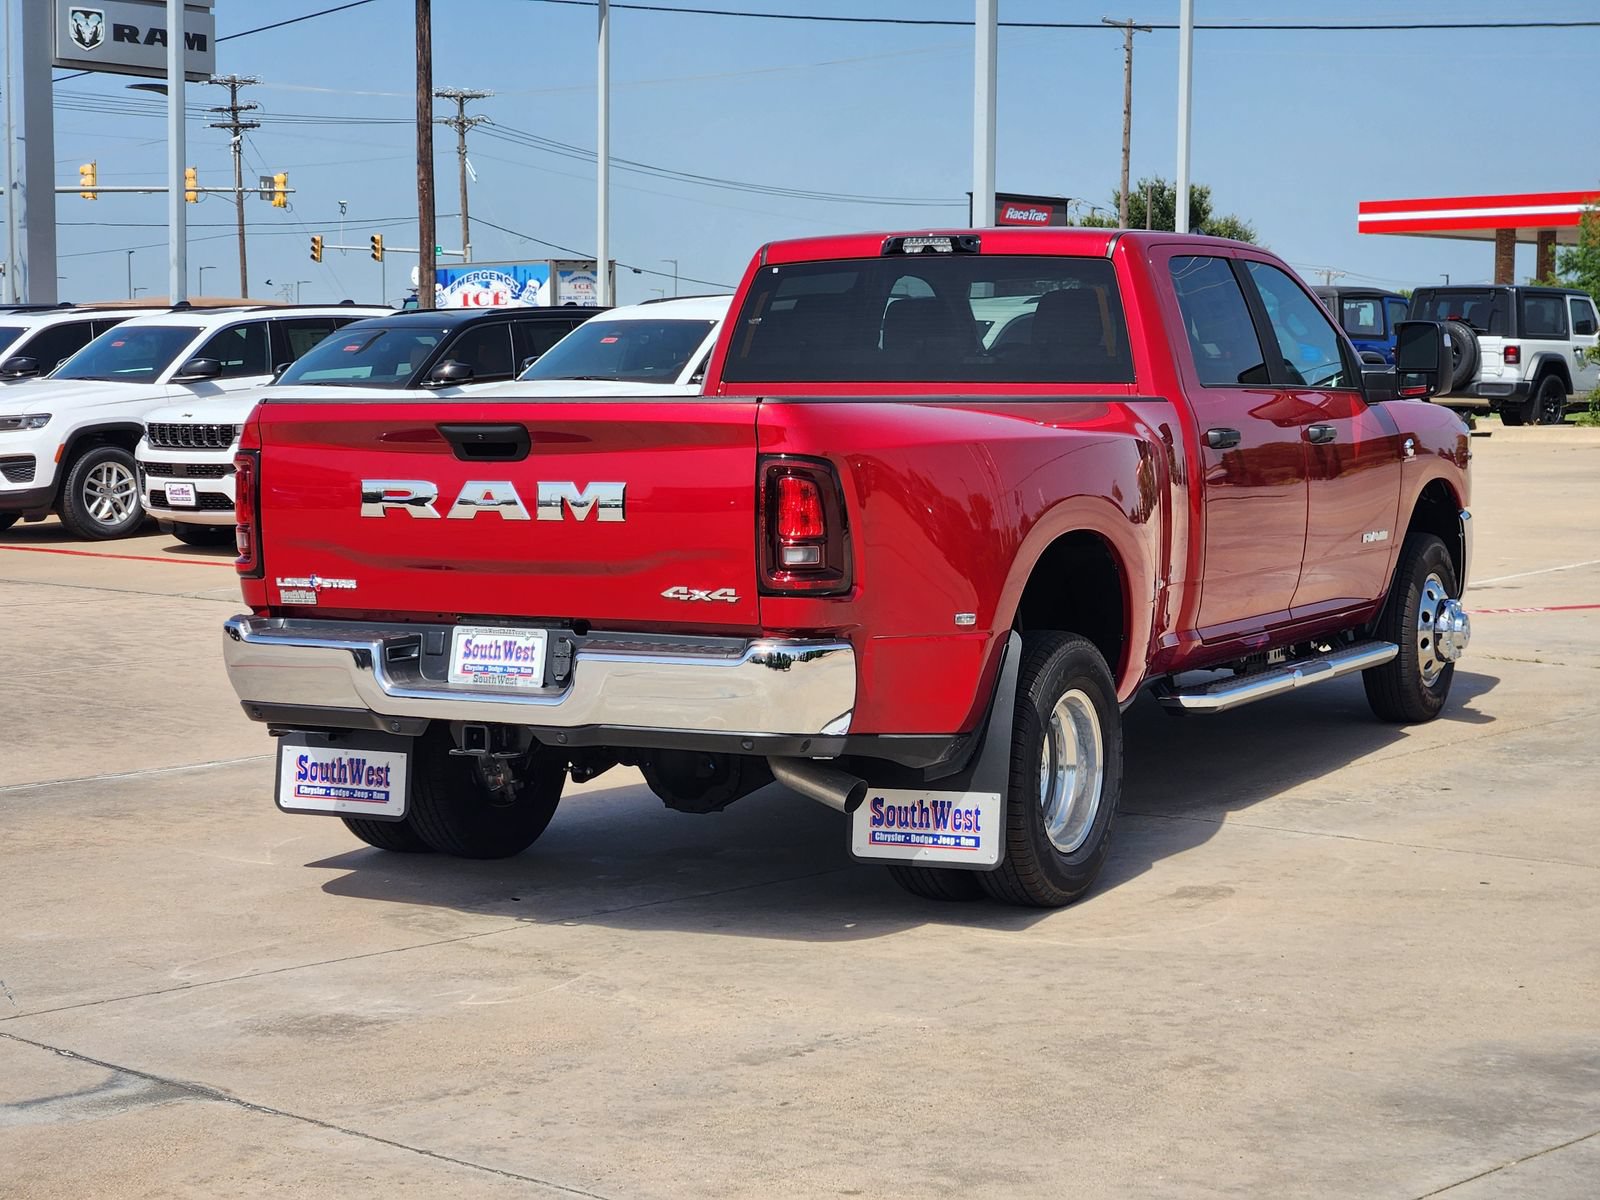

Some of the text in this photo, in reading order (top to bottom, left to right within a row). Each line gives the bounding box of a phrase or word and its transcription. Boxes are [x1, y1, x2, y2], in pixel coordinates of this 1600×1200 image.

[113, 23, 207, 52] RAM
[1005, 207, 1048, 221] RaceTrac
[450, 271, 521, 294] EMERGENCY
[460, 290, 508, 307] ICE
[361, 479, 626, 521] RAM
[1362, 530, 1388, 543] RAM
[320, 579, 357, 589] STAR
[660, 586, 742, 603] 4x4
[463, 638, 536, 662] SouthWest
[464, 664, 484, 673] Chrysler
[488, 665, 503, 674] Dodge
[507, 666, 518, 674] Jeep
[473, 674, 518, 686] SouthWest
[296, 754, 391, 788] SouthWest
[299, 785, 385, 800] Chrysler Dodge Jeep Ram
[870, 797, 981, 833] SouthWest
[875, 832, 975, 847] Chrysler Dodge Jeep Ram
